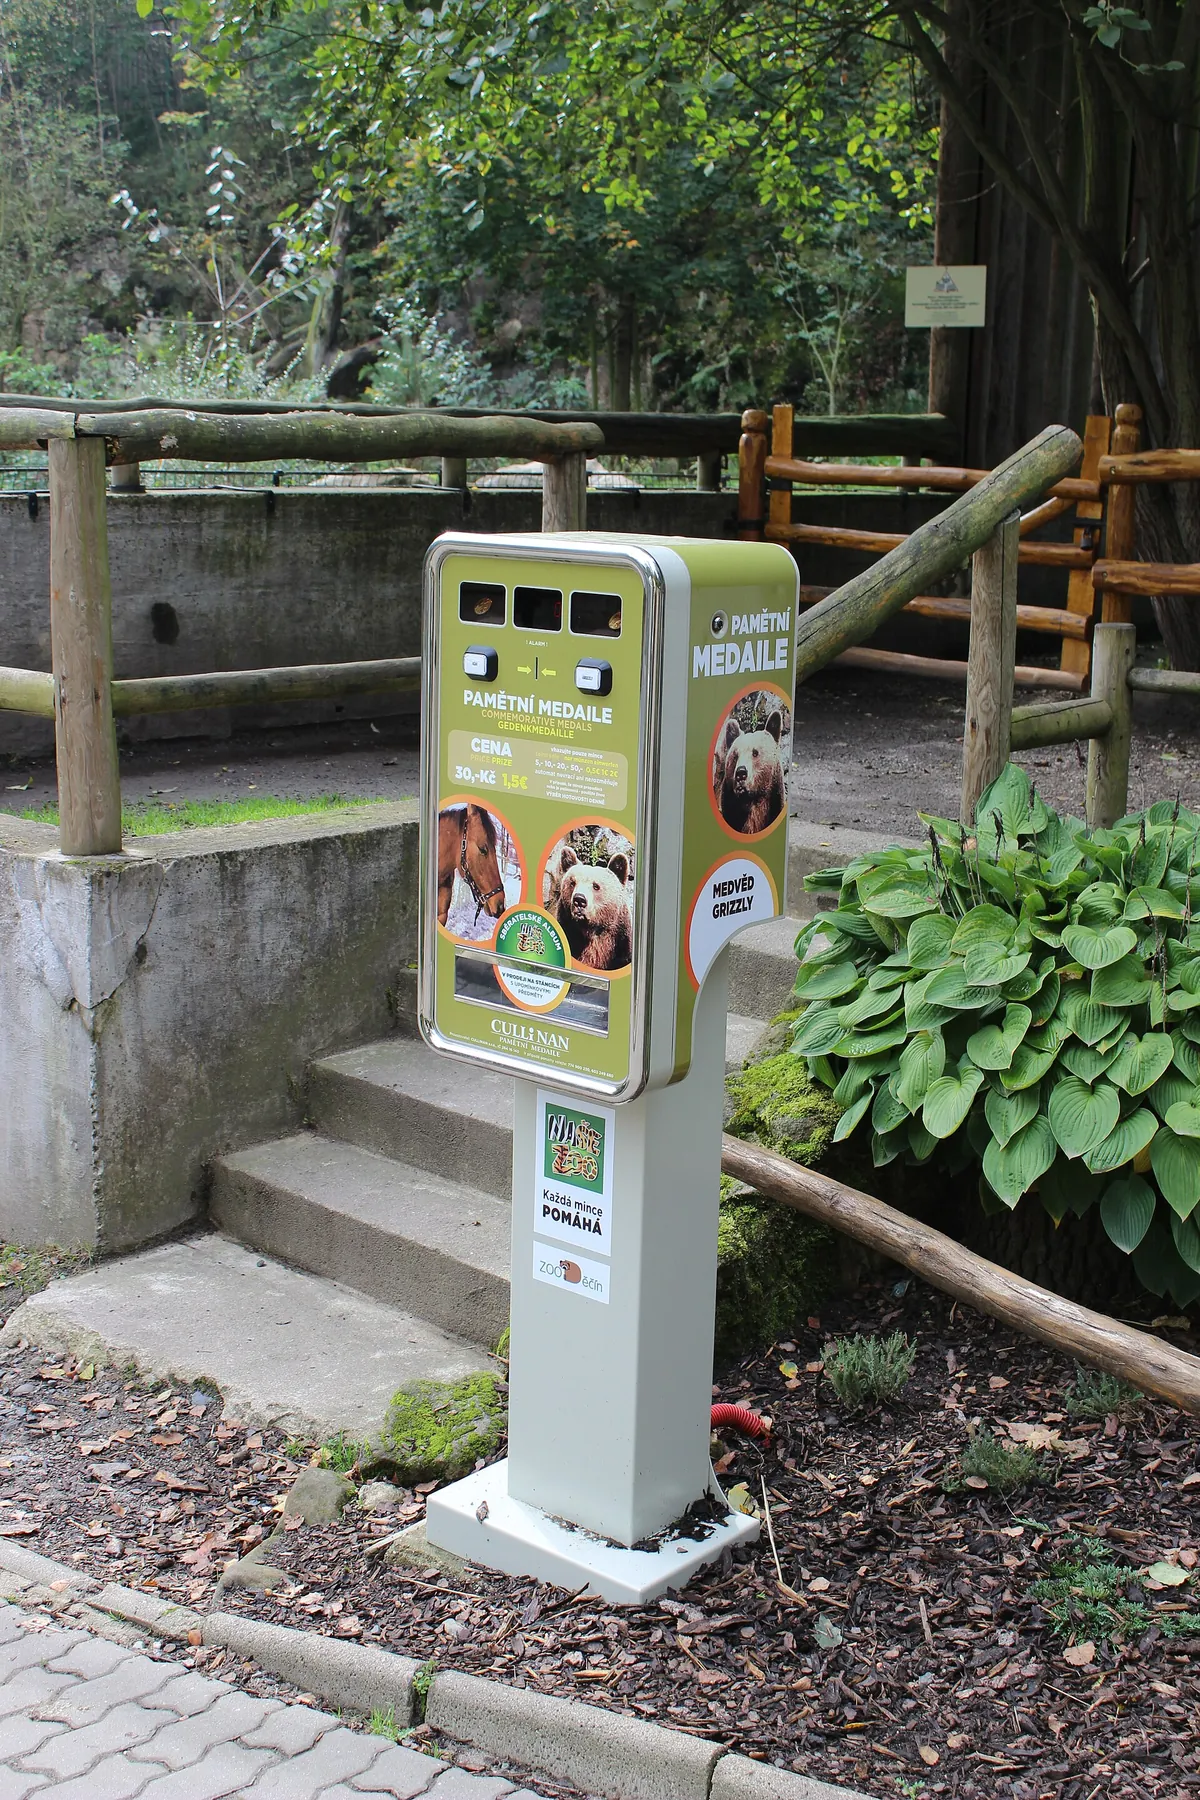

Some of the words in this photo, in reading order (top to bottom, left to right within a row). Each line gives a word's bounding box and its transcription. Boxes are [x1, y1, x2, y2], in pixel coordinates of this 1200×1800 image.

[731, 606, 791, 636] PAMĚTNÍ
[692, 638, 789, 679] MEDAILE
[463, 689, 535, 714] PAMĚTNÍ
[539, 700, 613, 724] MEDAILE
[481, 709, 556, 728] COMMEMORATIVE
[557, 719, 592, 732] MEDALS
[497, 721, 575, 739] GEDENKMEDAILLE
[470, 754, 491, 764] PRICE
[492, 756, 512, 766] PRIZE
[471, 737, 513, 757] CENA
[455, 765, 496, 784] 30,-Kč
[502, 772, 528, 790] 1,5€
[712, 873, 755, 899] MEDVĚD
[712, 895, 754, 919] GRIZZLY
[499, 913, 542, 941] SBĚRATELSKÉ
[542, 922, 562, 951] ALBUM
[530, 1044, 560, 1058] MEDAILE
[547, 1113, 602, 1157] NAŠE
[551, 1143, 598, 1181] ZOO
[543, 1188, 572, 1208] Každá
[574, 1200, 603, 1217] mince
[542, 1204, 603, 1236] POMÁHÁ
